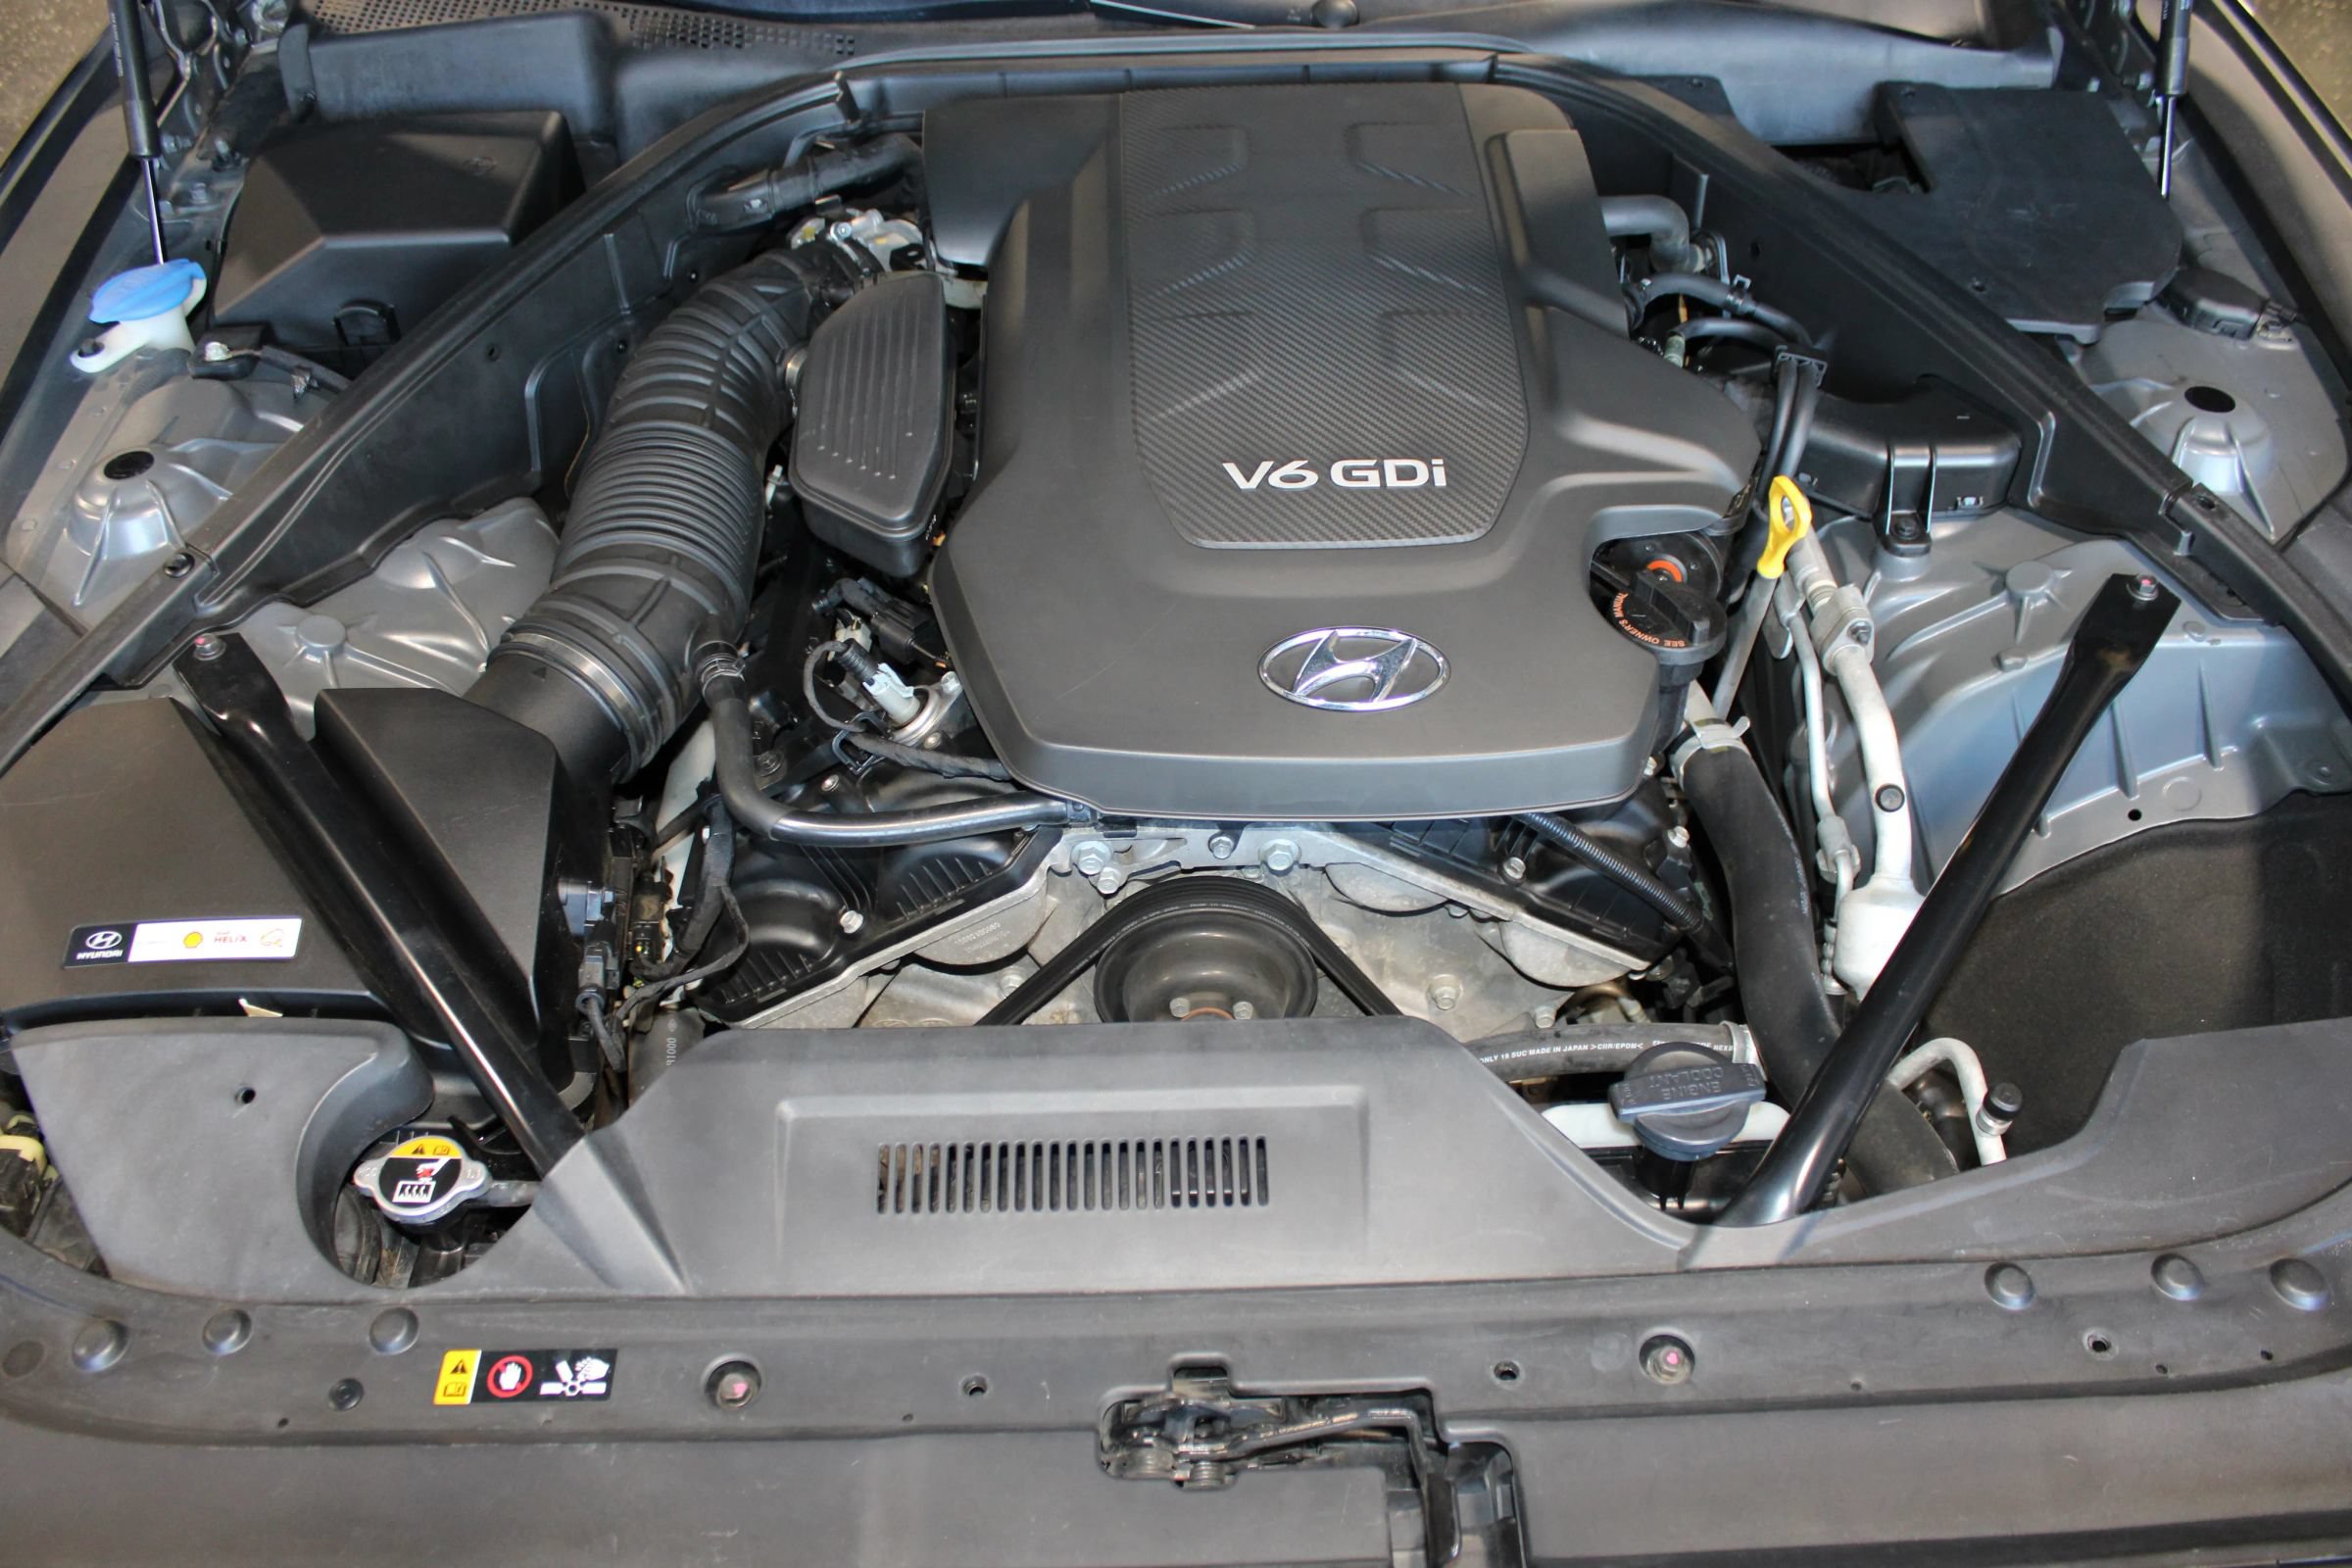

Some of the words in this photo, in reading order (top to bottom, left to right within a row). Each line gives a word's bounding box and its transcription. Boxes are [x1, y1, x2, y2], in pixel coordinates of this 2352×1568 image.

[1222, 460, 1319, 490] V6
[1330, 458, 1447, 488] GDi
[1619, 619, 1660, 645] OWNER'S
[1664, 639, 1686, 648] SEE
[75, 949, 123, 960] HYUNDAI
[1529, 1047, 1551, 1055] MADE
[1648, 1066, 1725, 1089] COOLANT
[1660, 1081, 1721, 1101] ENGINE
